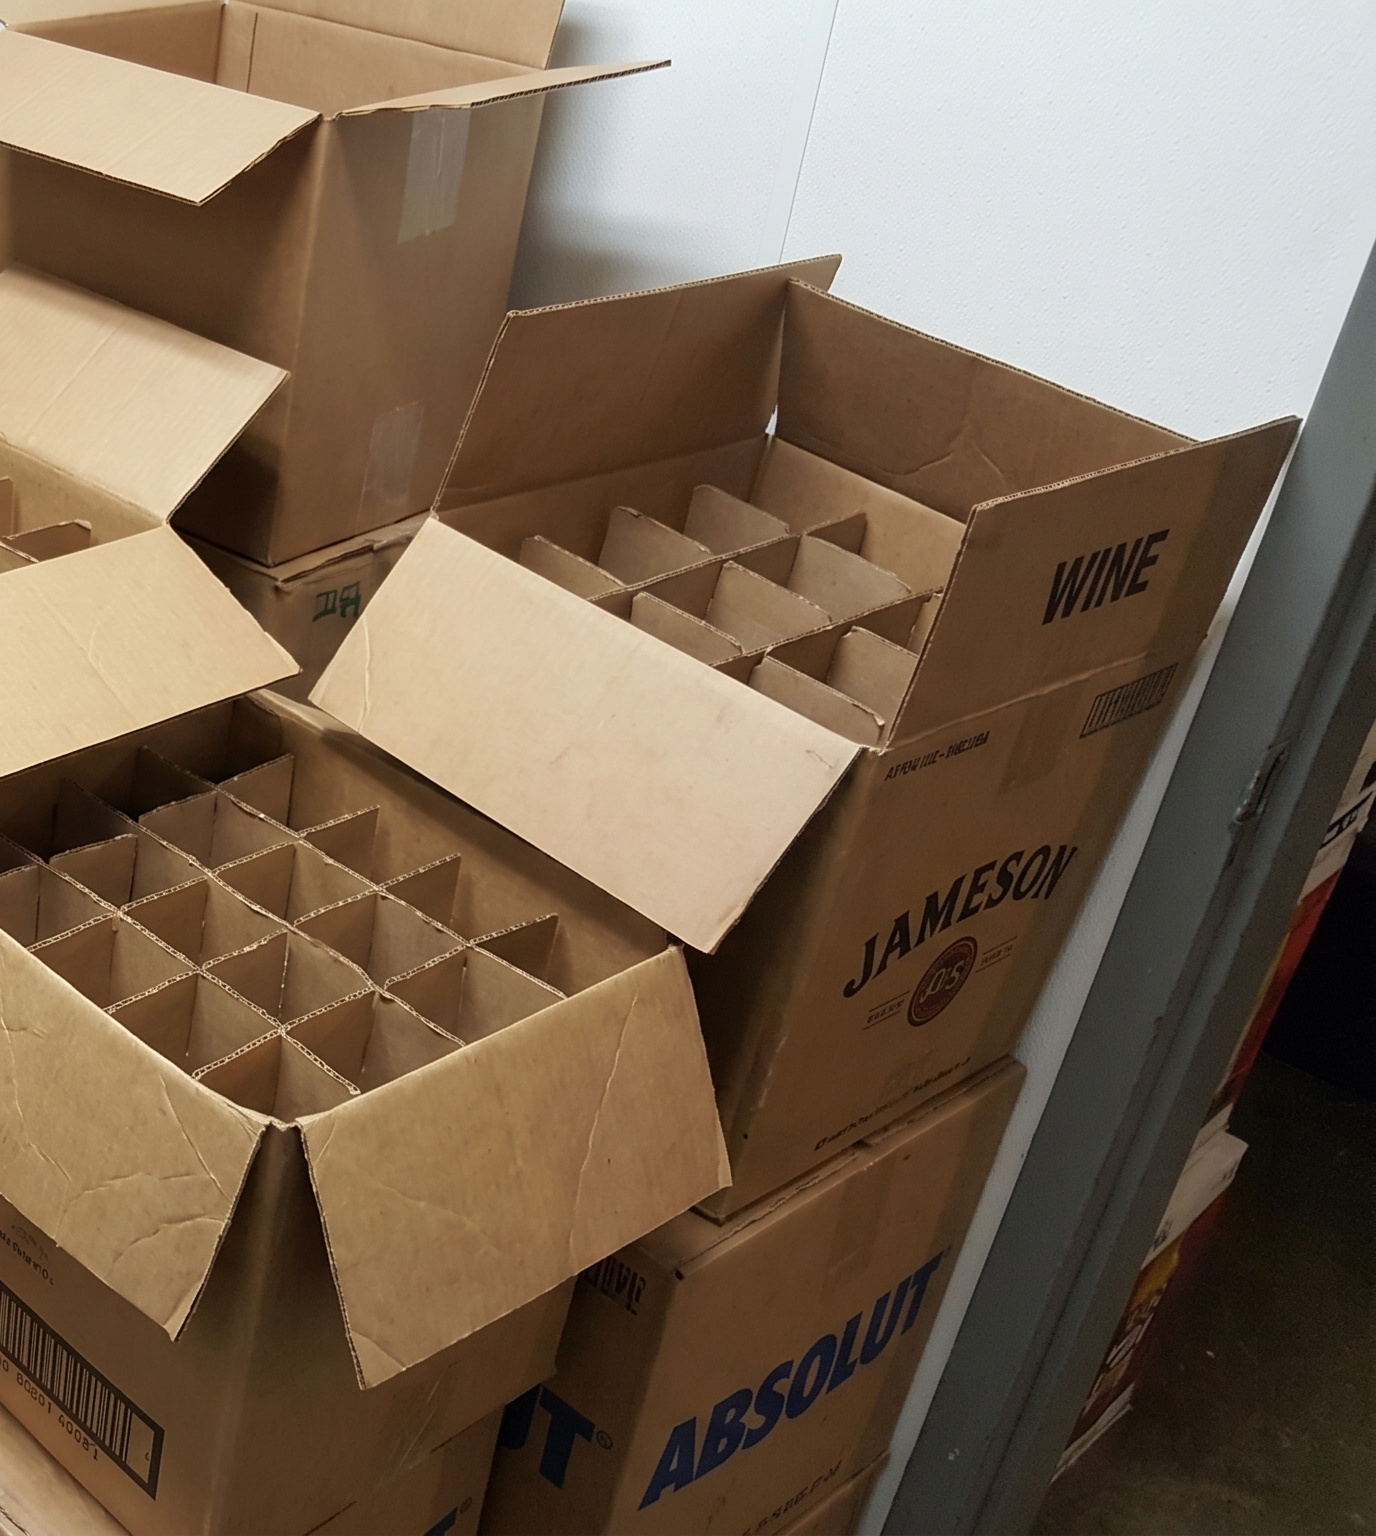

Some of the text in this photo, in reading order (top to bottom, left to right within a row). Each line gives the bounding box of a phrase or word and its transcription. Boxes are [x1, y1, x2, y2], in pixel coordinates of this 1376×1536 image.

[1041, 529, 1169, 625] WINE
[843, 844, 1078, 998] JAMESON
[638, 1251, 944, 1510] ABSOLUT
